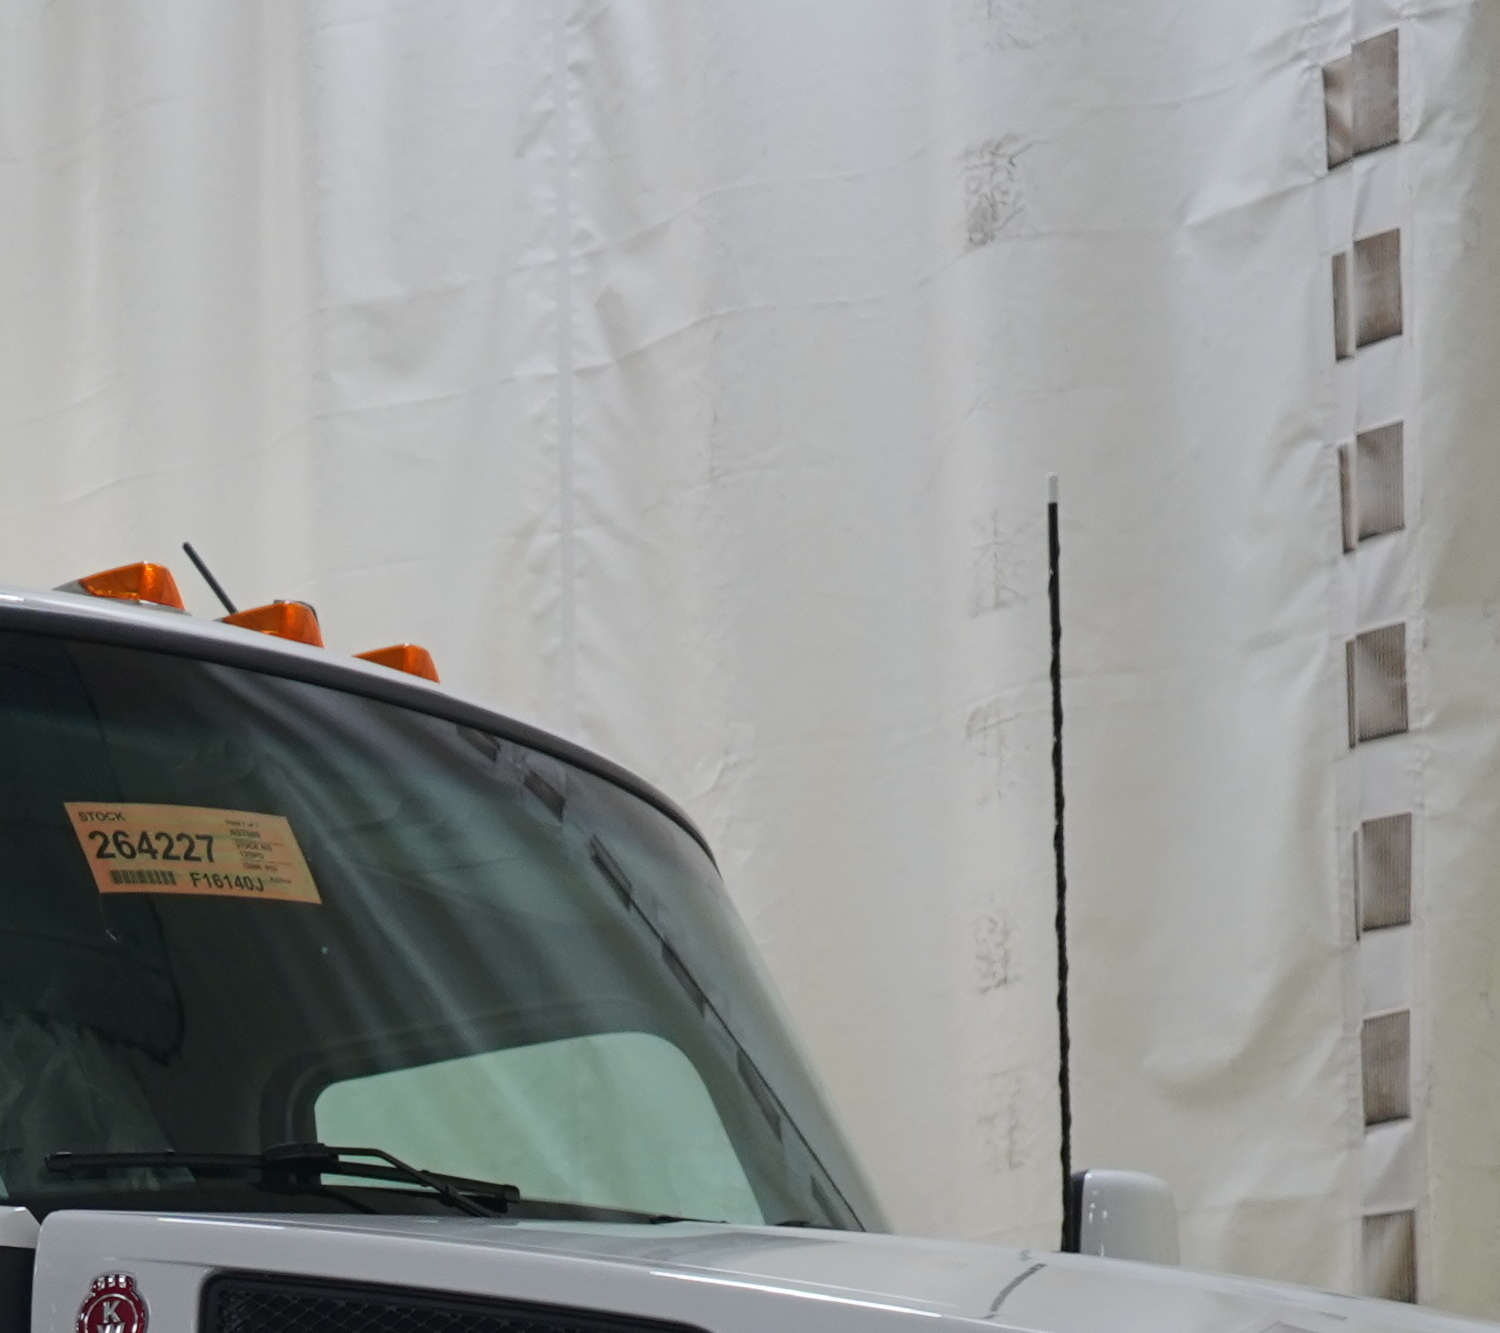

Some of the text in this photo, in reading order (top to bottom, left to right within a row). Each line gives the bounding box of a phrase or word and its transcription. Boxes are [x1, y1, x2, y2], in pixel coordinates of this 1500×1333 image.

[78, 811, 125, 823] STOCK
[88, 831, 216, 863] 264227
[189, 872, 265, 892] F16140J
